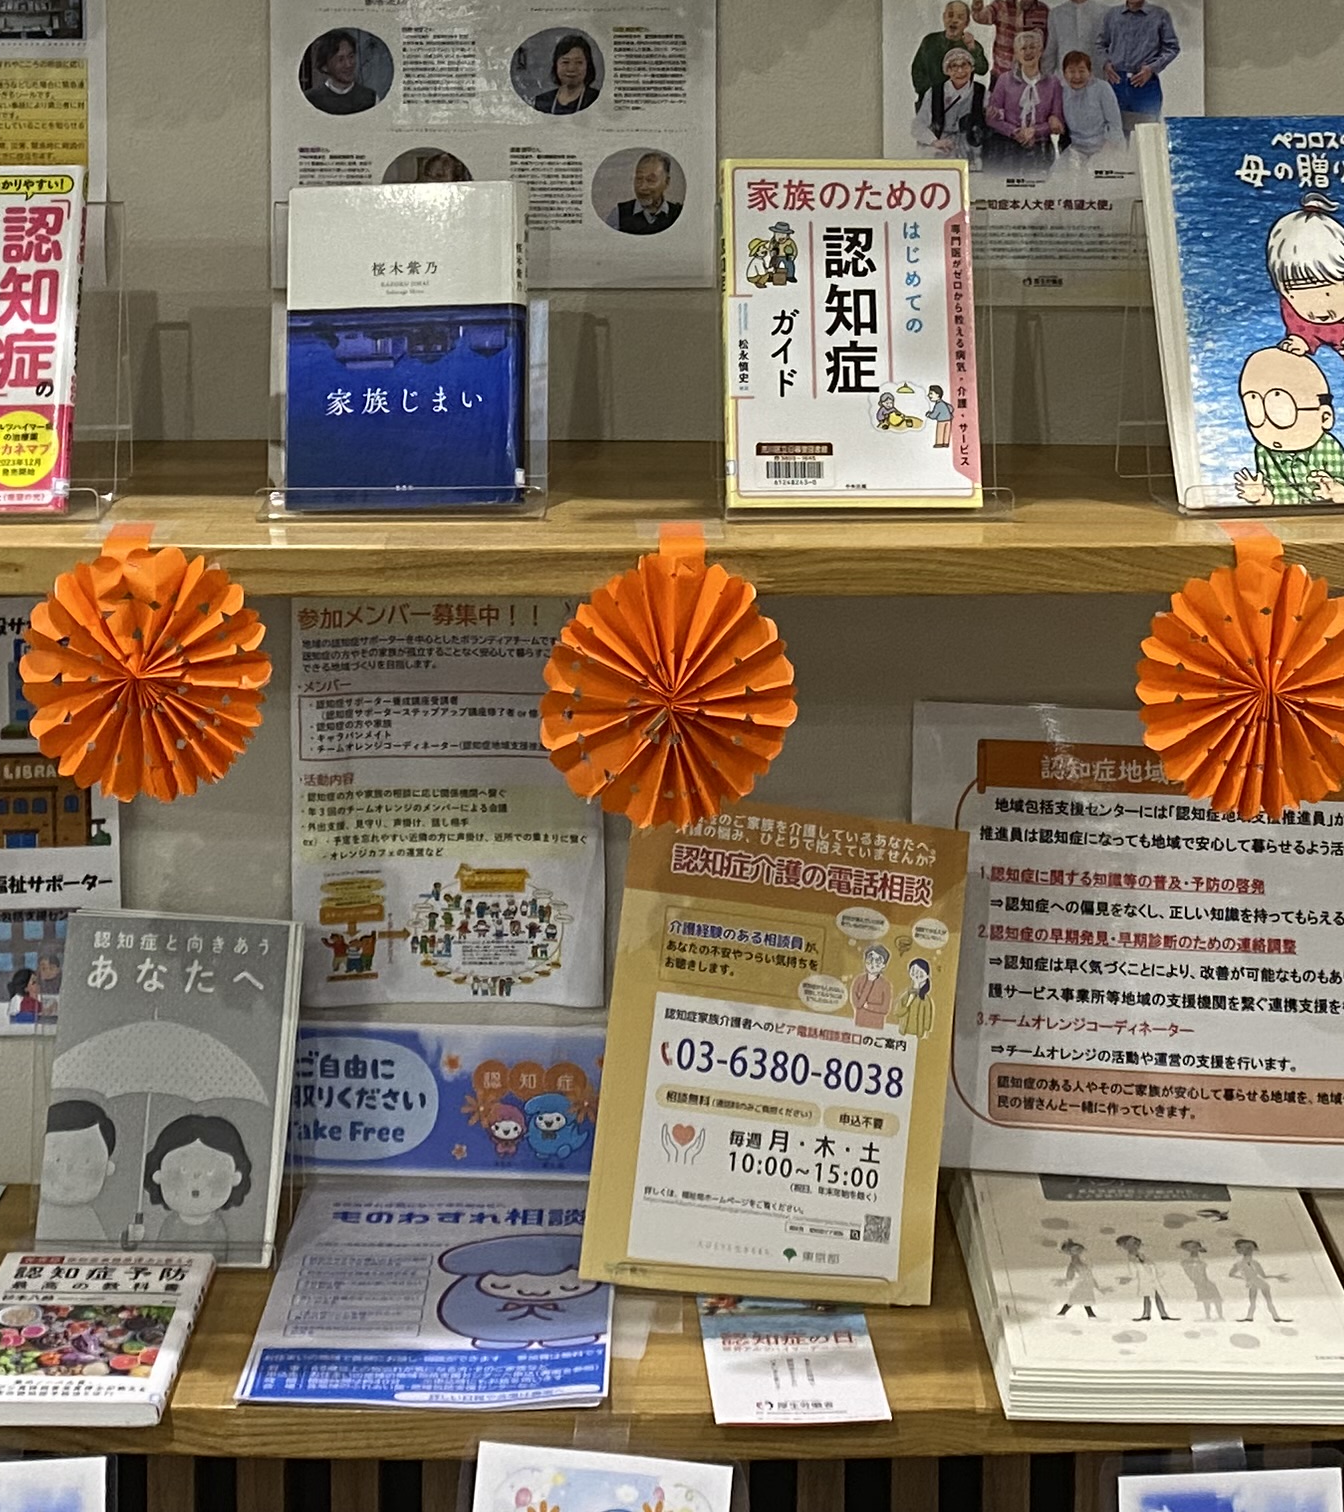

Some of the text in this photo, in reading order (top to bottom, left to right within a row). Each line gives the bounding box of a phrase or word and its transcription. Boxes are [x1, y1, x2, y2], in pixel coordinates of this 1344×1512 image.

[747, 180, 951, 212] 家族のための
[371, 262, 438, 277] 桜木紫乃
[903, 221, 923, 334] はじめての
[823, 226, 879, 394] 認知症
[770, 309, 799, 397] ガイド
[325, 386, 483, 416] 家族じまい
[672, 844, 933, 906] 認知症介護の電話相談
[94, 931, 269, 955] 認知症と向きあう
[87, 955, 264, 993] あなたへ
[484, 1072, 574, 1090] 認知症
[676, 1038, 905, 1099] 03-6380-8038
[996, 1094, 1200, 1120] 民の皆さんと一緒に作っていきます。
[350, 1121, 405, 1143] Free
[728, 1130, 762, 1150] 毎週
[14, 1266, 190, 1281] 認知症予防
